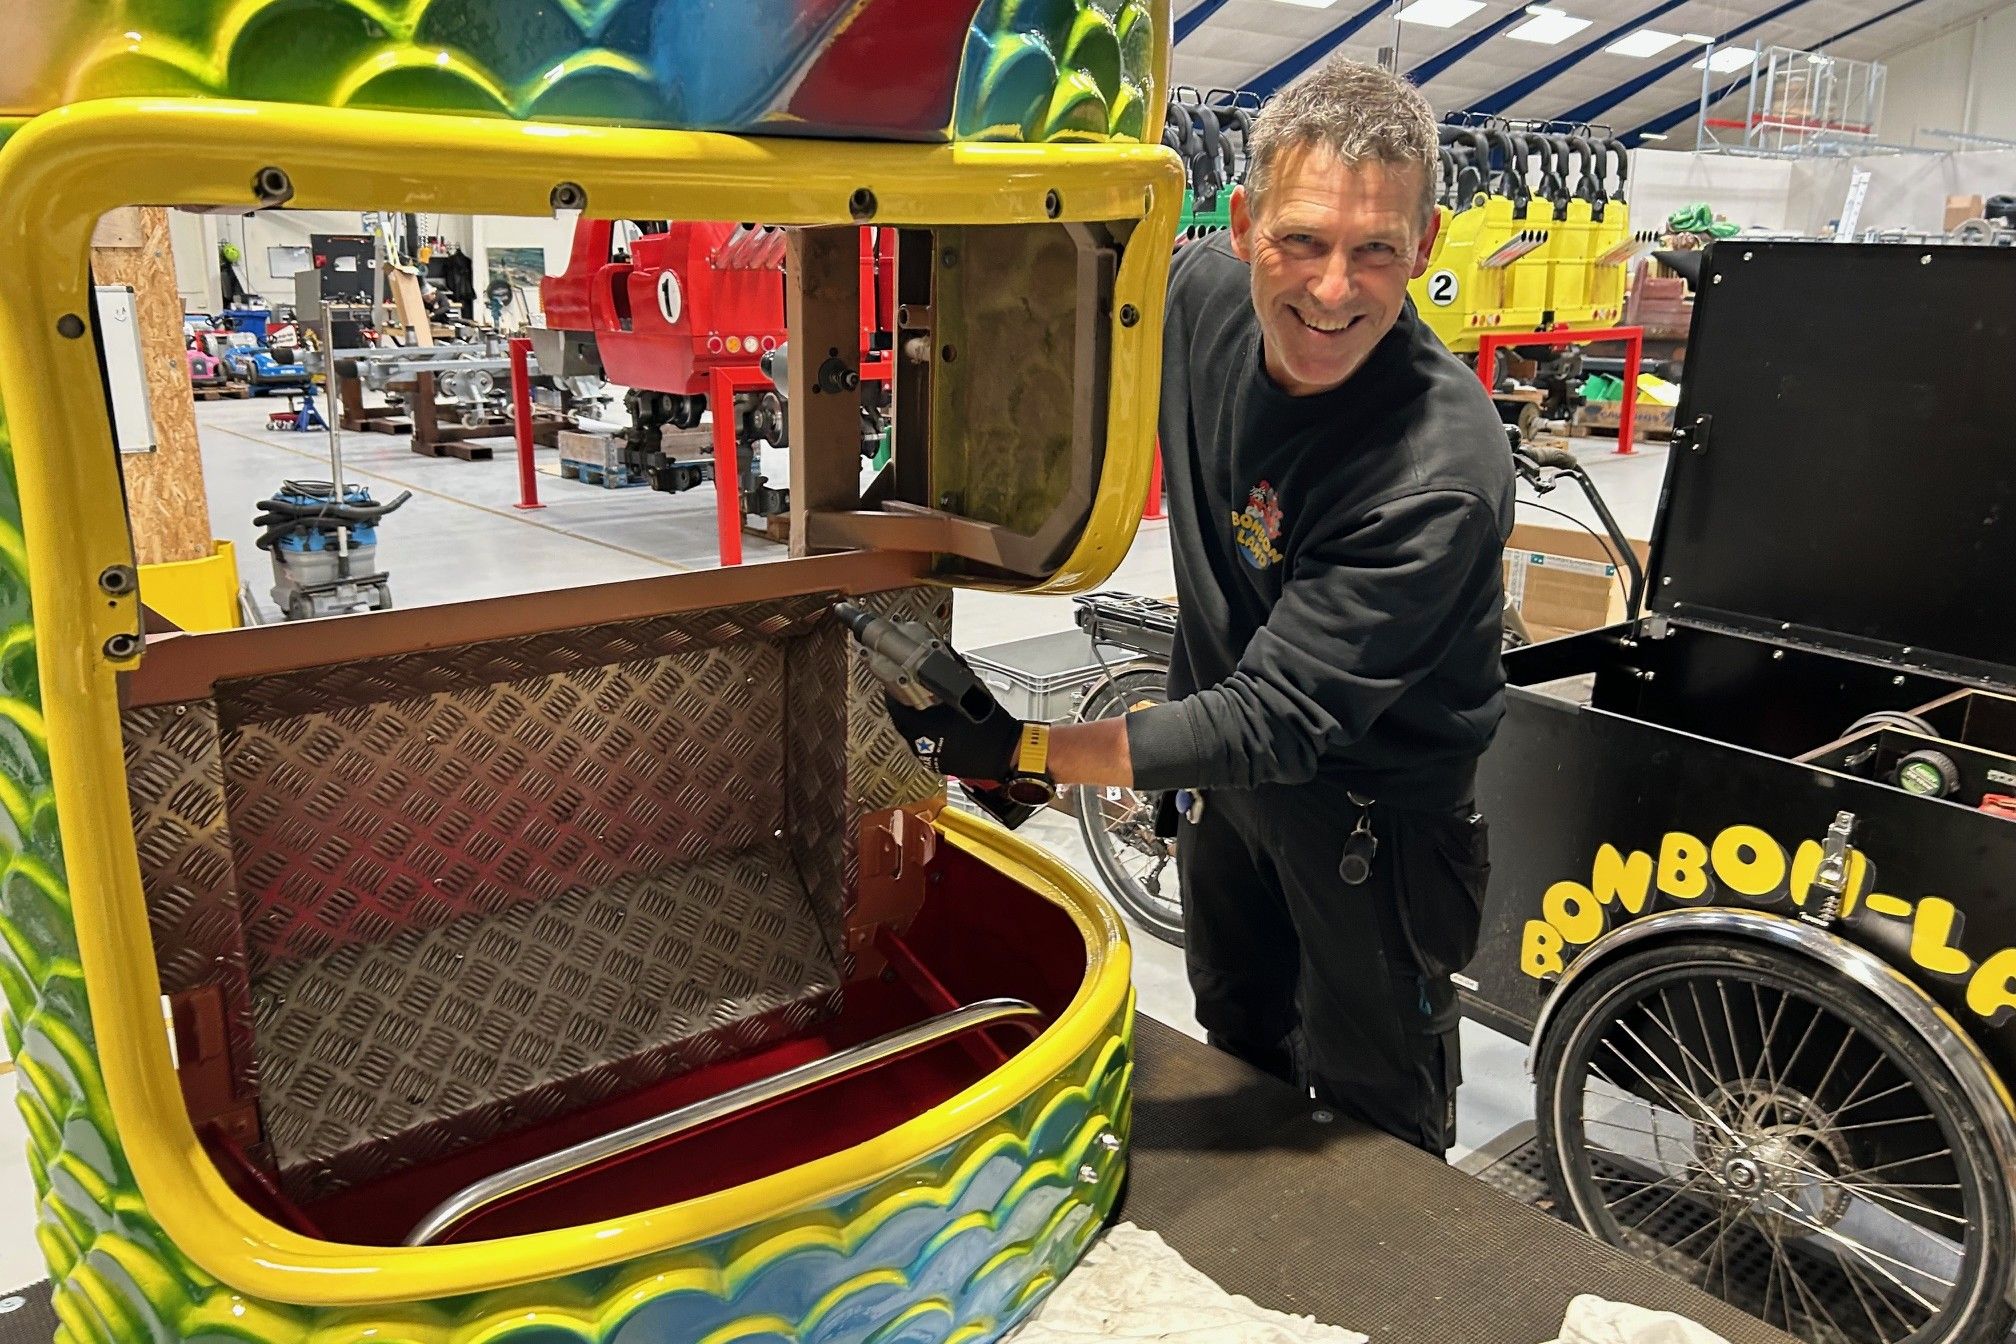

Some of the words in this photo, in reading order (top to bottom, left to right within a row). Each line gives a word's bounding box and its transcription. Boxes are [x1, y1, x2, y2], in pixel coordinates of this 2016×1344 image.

[661, 278, 673, 317] 1
[1434, 274, 1452, 301] 2
[1236, 528, 1268, 568] LAND
